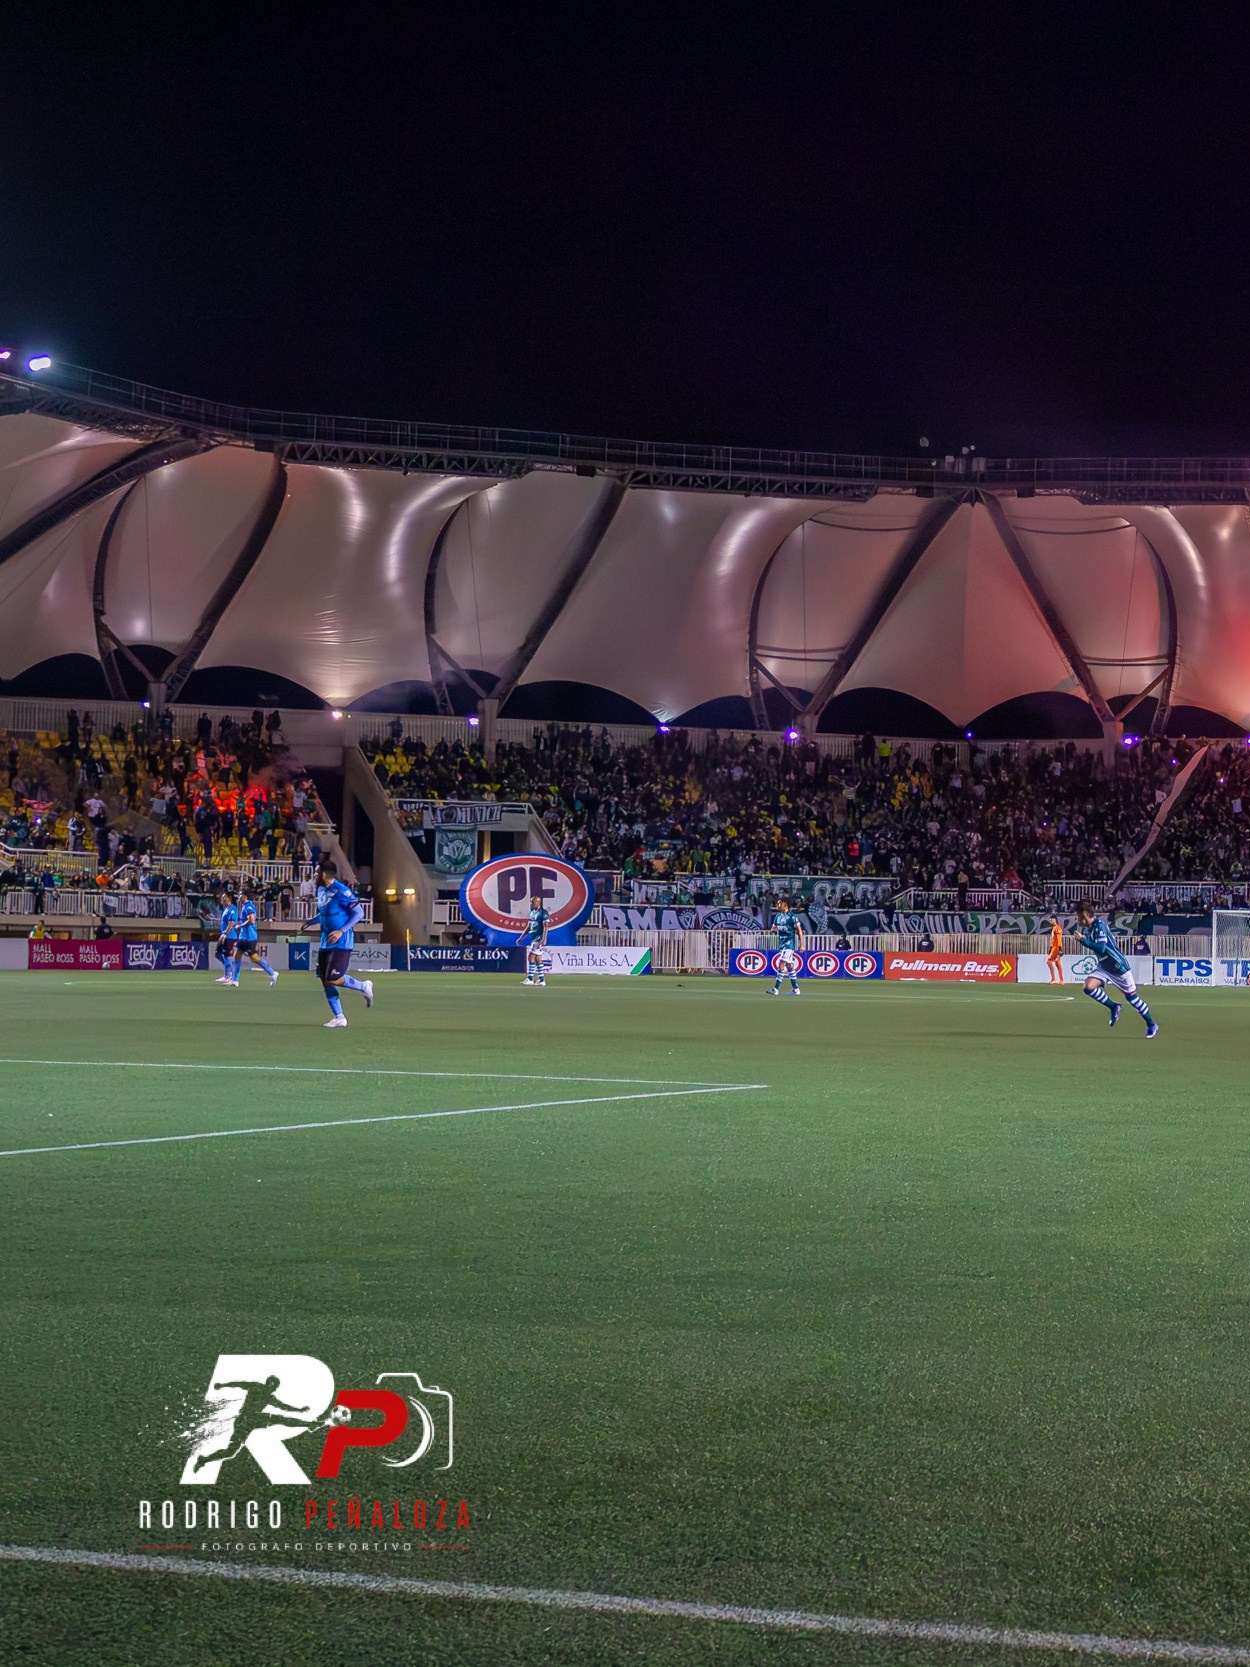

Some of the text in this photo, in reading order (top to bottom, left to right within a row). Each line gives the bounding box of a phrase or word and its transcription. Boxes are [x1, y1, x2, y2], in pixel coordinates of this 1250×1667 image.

[497, 867, 557, 914] PF
[33, 953, 54, 963] PASEO
[79, 954, 100, 963] PASEO
[127, 944, 159, 969] Teddy
[170, 945, 201, 970] Teddy
[478, 948, 508, 960] LEÓN
[557, 952, 634, 967] Viña Bus S.A.
[745, 956, 760, 969] PF
[816, 956, 831, 970] PF
[853, 957, 868, 970] PF
[889, 959, 961, 972] Pullman
[1156, 959, 1212, 977] TPS
